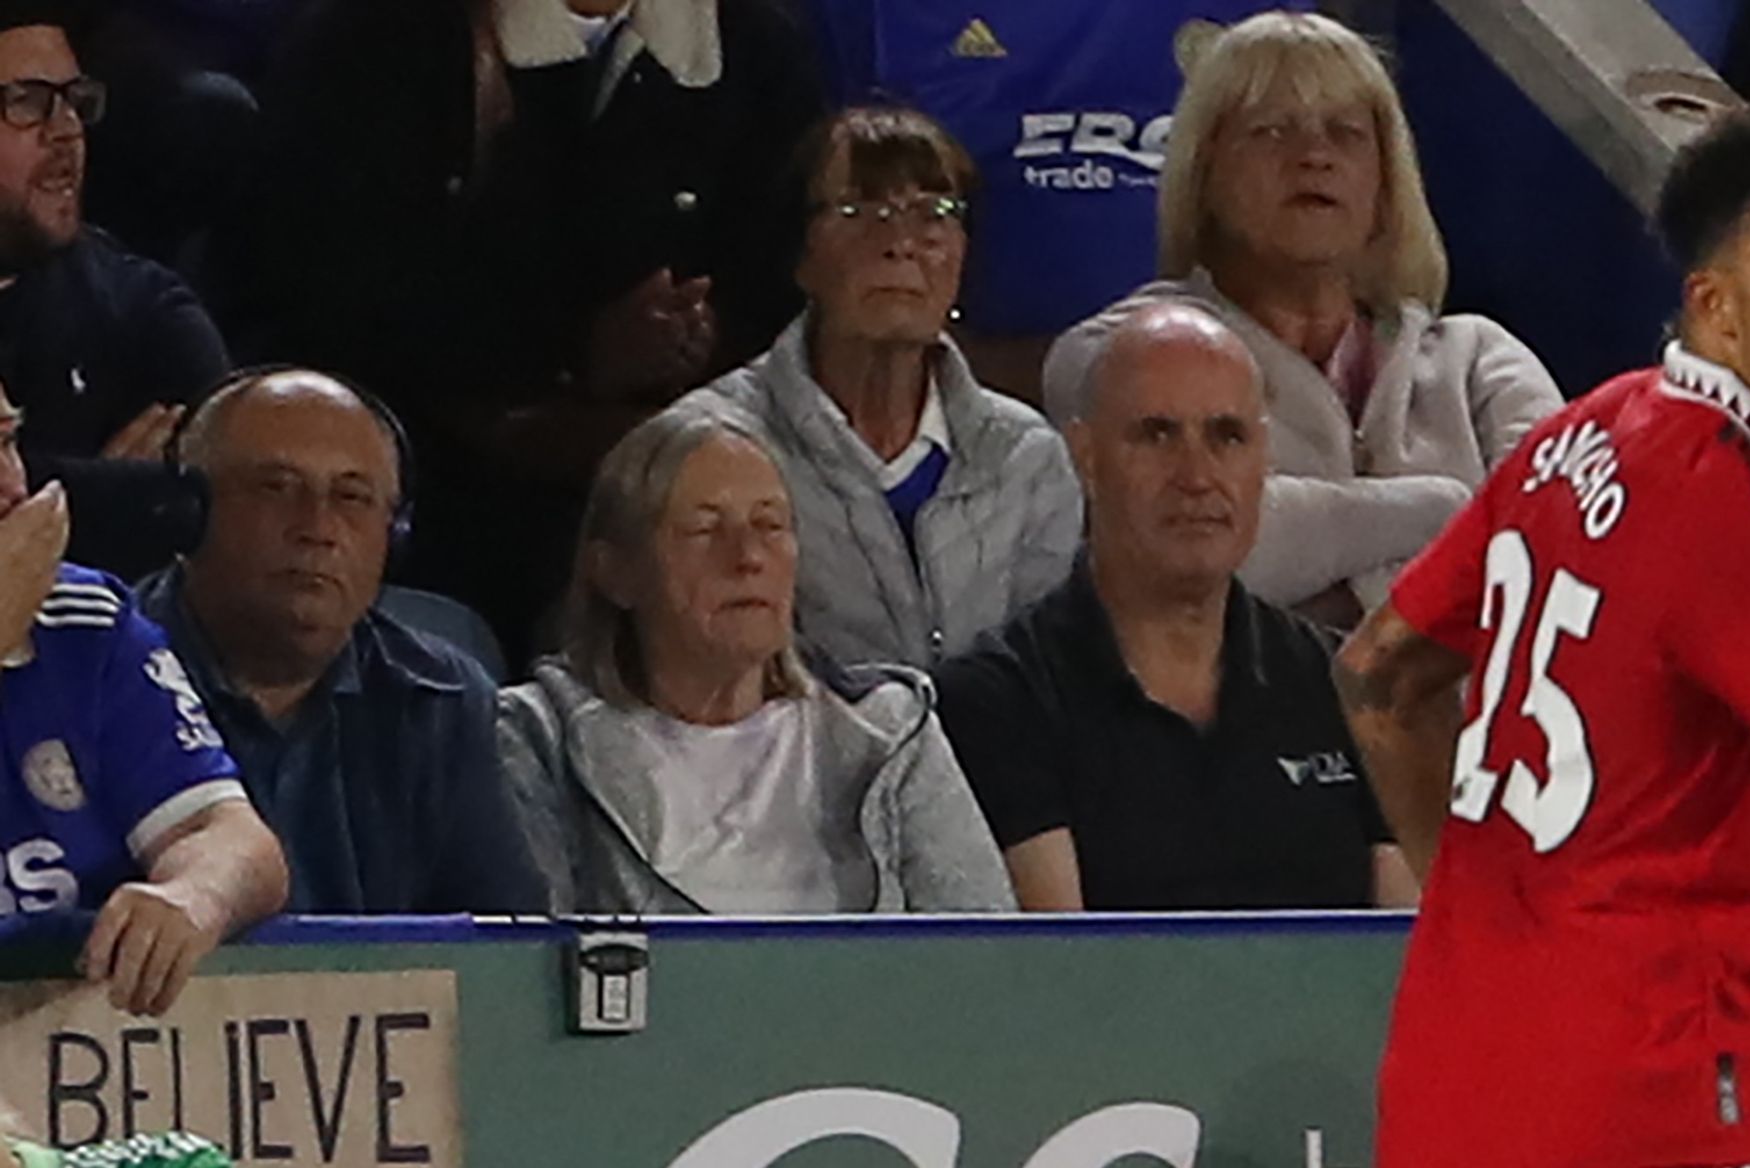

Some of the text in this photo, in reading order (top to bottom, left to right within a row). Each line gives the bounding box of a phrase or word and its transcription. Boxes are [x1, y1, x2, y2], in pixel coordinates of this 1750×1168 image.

[1024, 158, 1114, 189] trade
[1522, 419, 1625, 540] SANCHO
[1449, 529, 1602, 853] 25
[47, 1013, 431, 1163] BELIEVE
